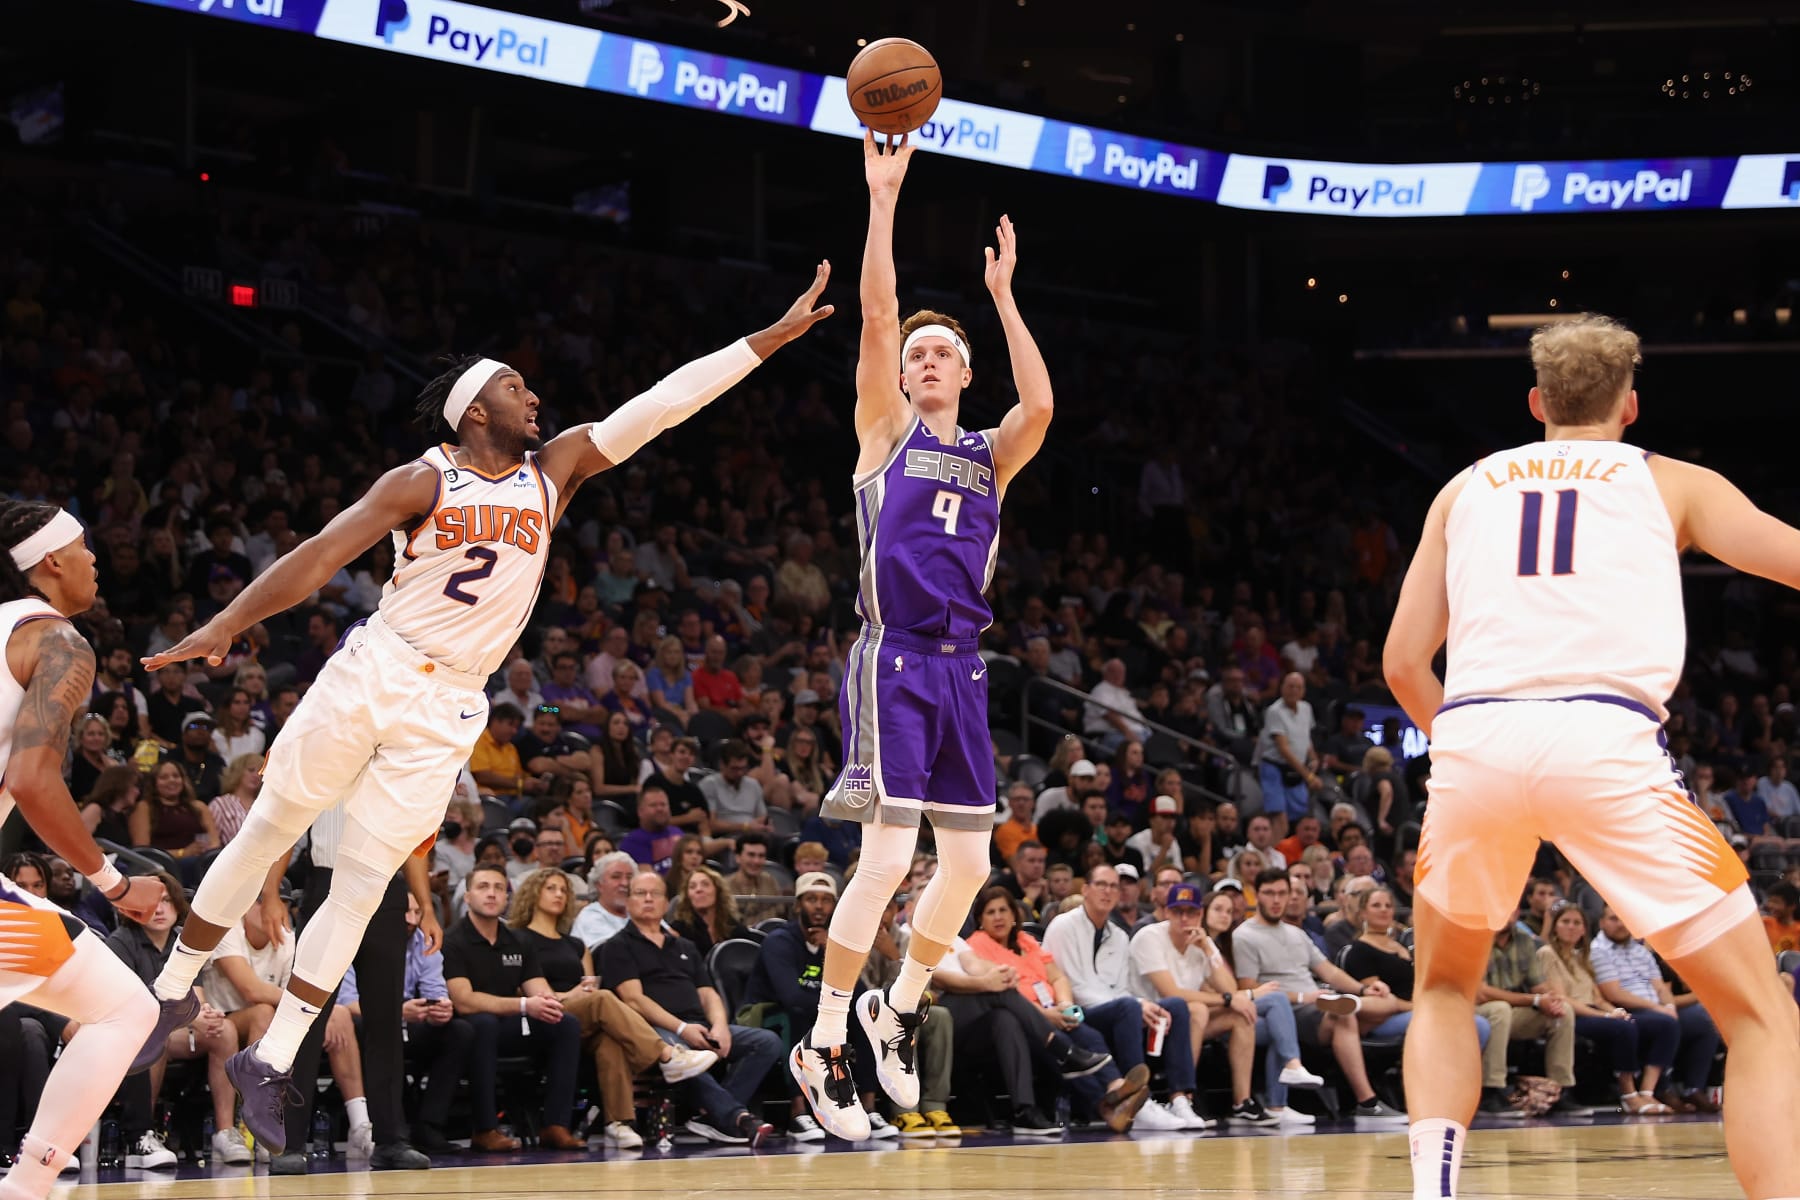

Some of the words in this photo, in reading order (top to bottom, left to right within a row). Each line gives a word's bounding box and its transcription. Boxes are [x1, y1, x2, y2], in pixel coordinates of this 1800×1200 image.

[427, 15, 548, 67] PayPal
[674, 61, 787, 114] PayPal
[863, 78, 929, 108] Wilson
[919, 117, 1000, 151] ayPal
[1104, 143, 1198, 190] PayPal
[1563, 169, 1693, 209] PayPal
[1309, 177, 1425, 209] PayPal
[904, 449, 991, 496] SAC
[1484, 458, 1628, 489] LANDALE
[434, 504, 543, 555] SUNS
[931, 490, 963, 535] 9
[1517, 488, 1578, 577] 11
[443, 546, 499, 606] 2
[845, 780, 871, 790] SAC
